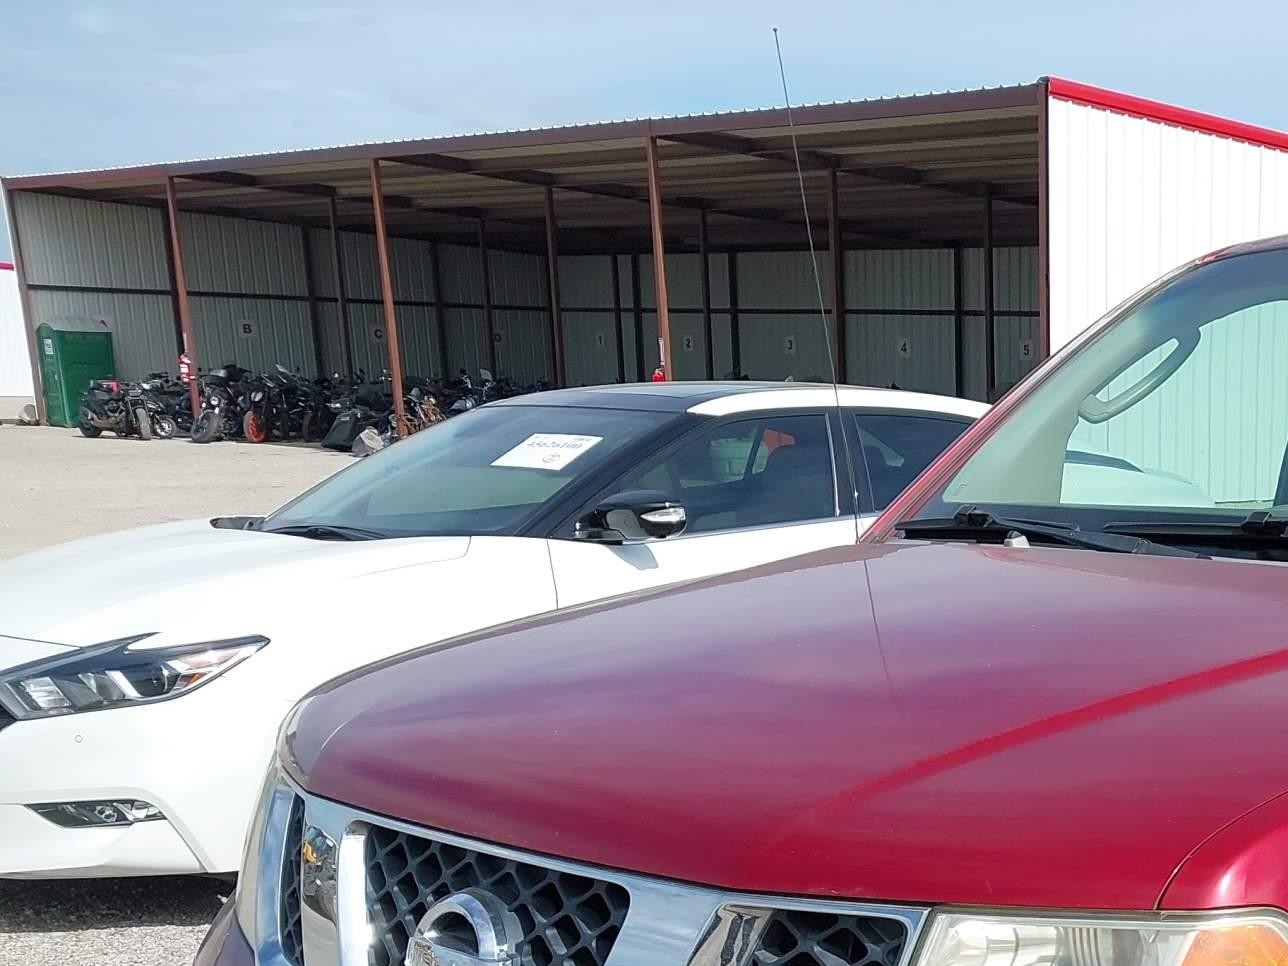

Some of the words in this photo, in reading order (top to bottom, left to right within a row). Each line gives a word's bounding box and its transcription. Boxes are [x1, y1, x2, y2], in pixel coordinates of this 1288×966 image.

[242, 323, 253, 334] B
[374, 328, 384, 339] C
[685, 338, 692, 349] 2
[787, 339, 794, 350] 3
[900, 342, 908, 353] 4
[1023, 344, 1030, 356] 5
